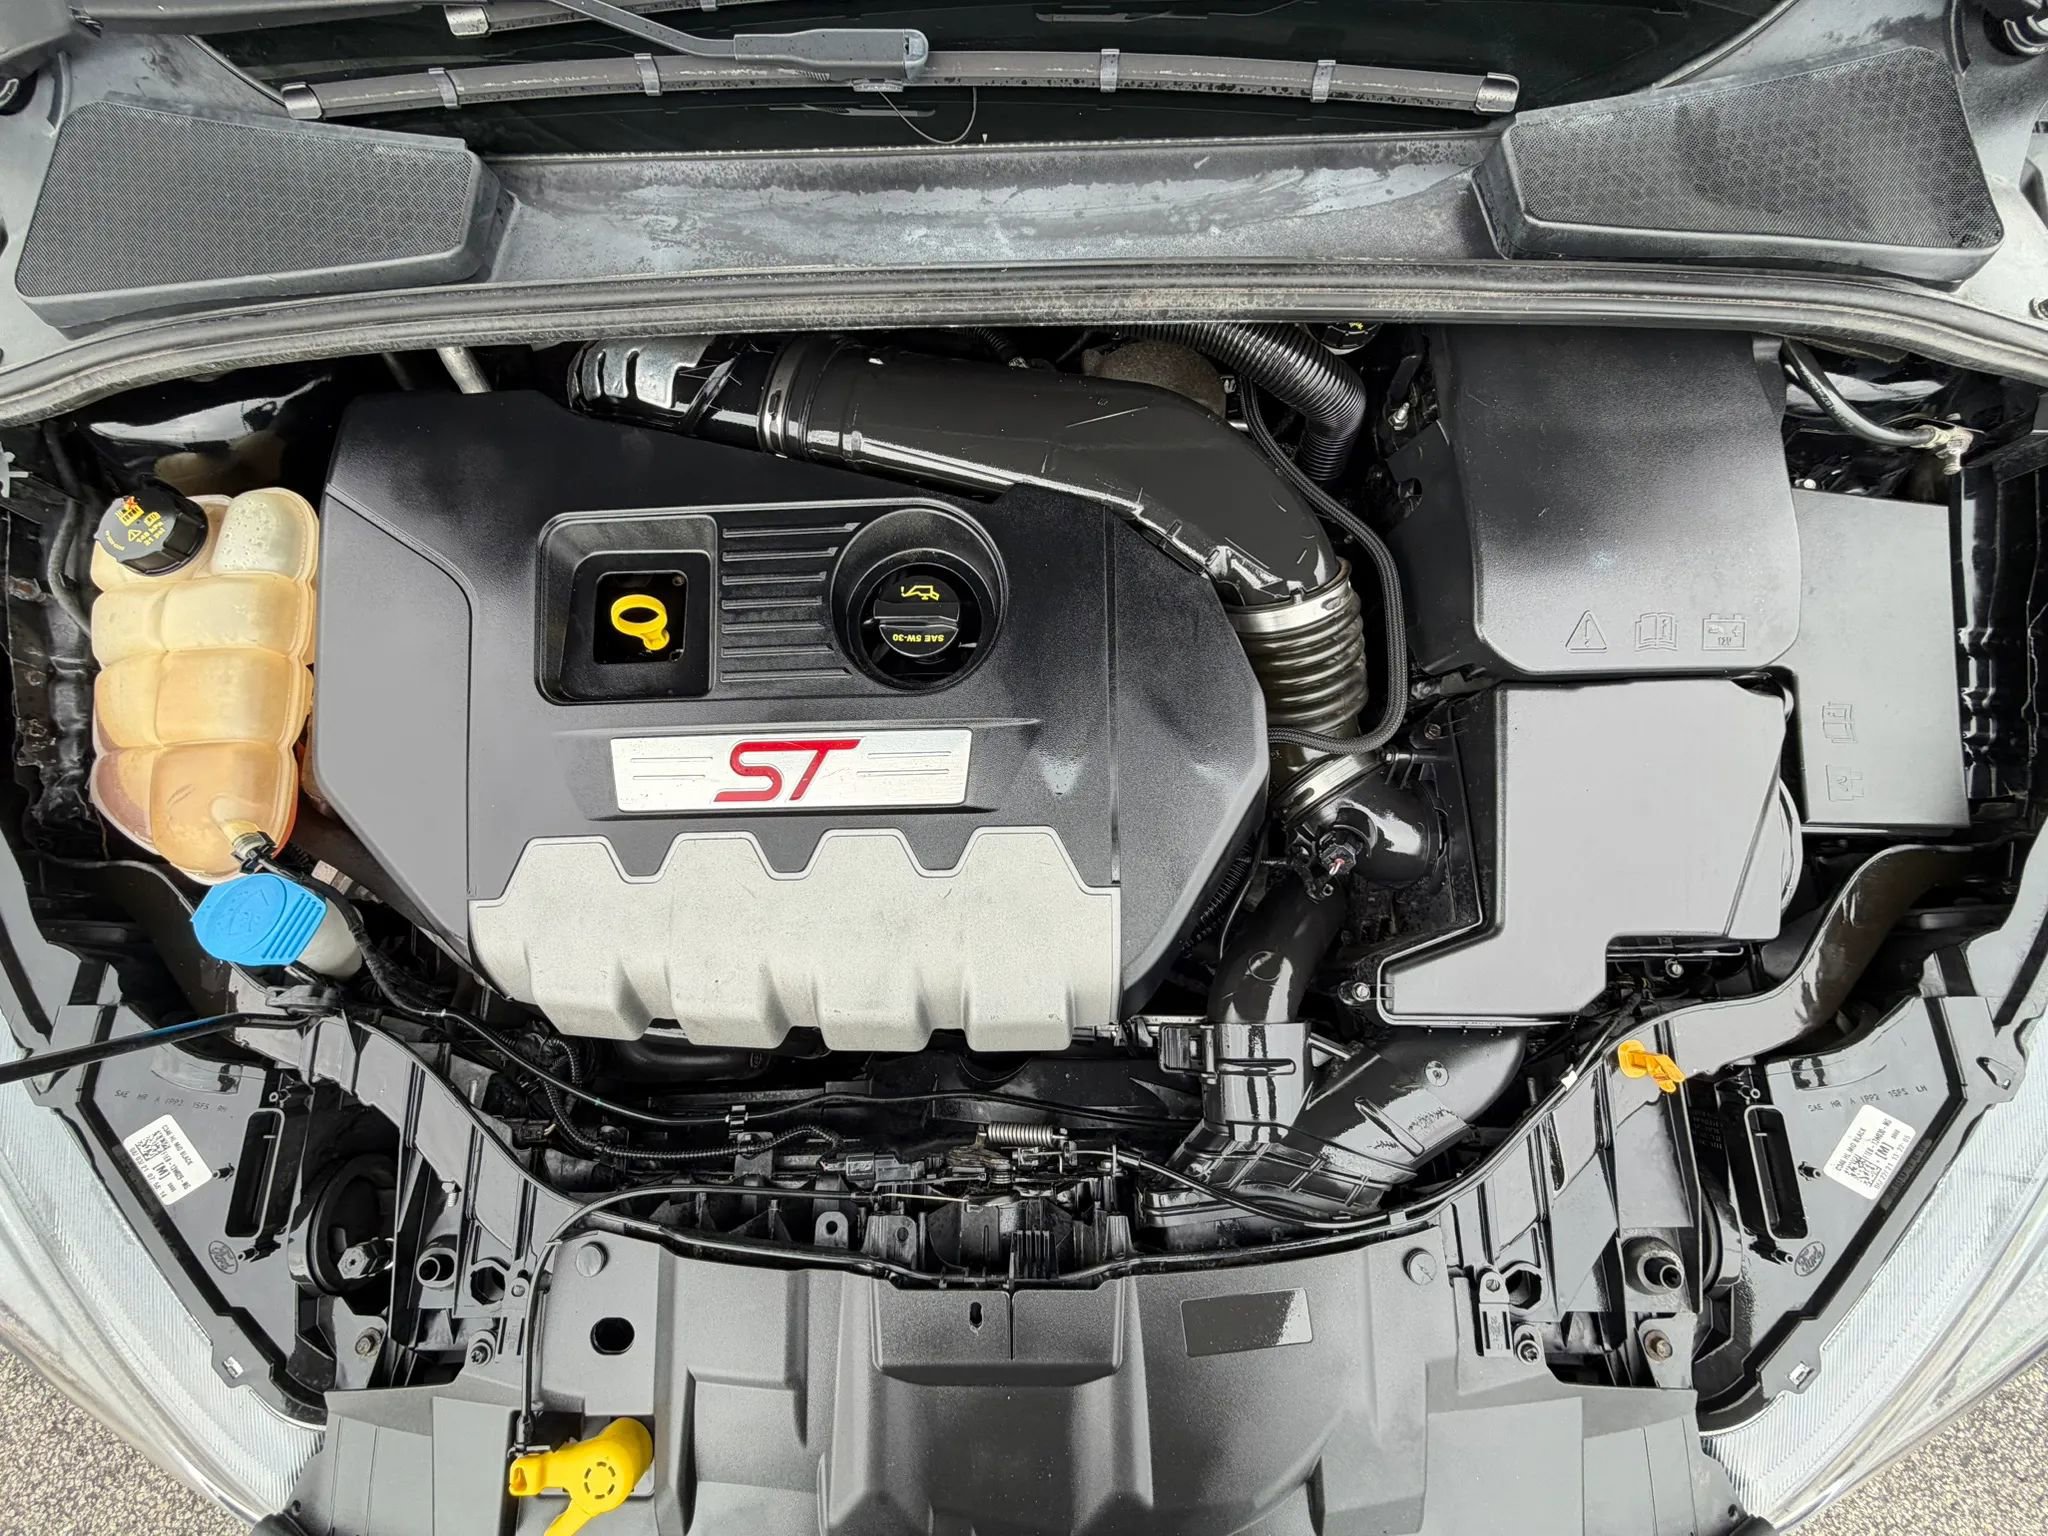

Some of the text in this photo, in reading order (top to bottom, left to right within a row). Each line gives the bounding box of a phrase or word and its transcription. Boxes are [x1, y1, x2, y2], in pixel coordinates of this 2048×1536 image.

[892, 633, 944, 642] SAE 5W-30
[714, 739, 861, 802] ST
[1807, 1104, 1823, 1112] SAE
[1852, 1126, 1866, 1143] BLACK
[179, 1150, 193, 1165] BLACK
